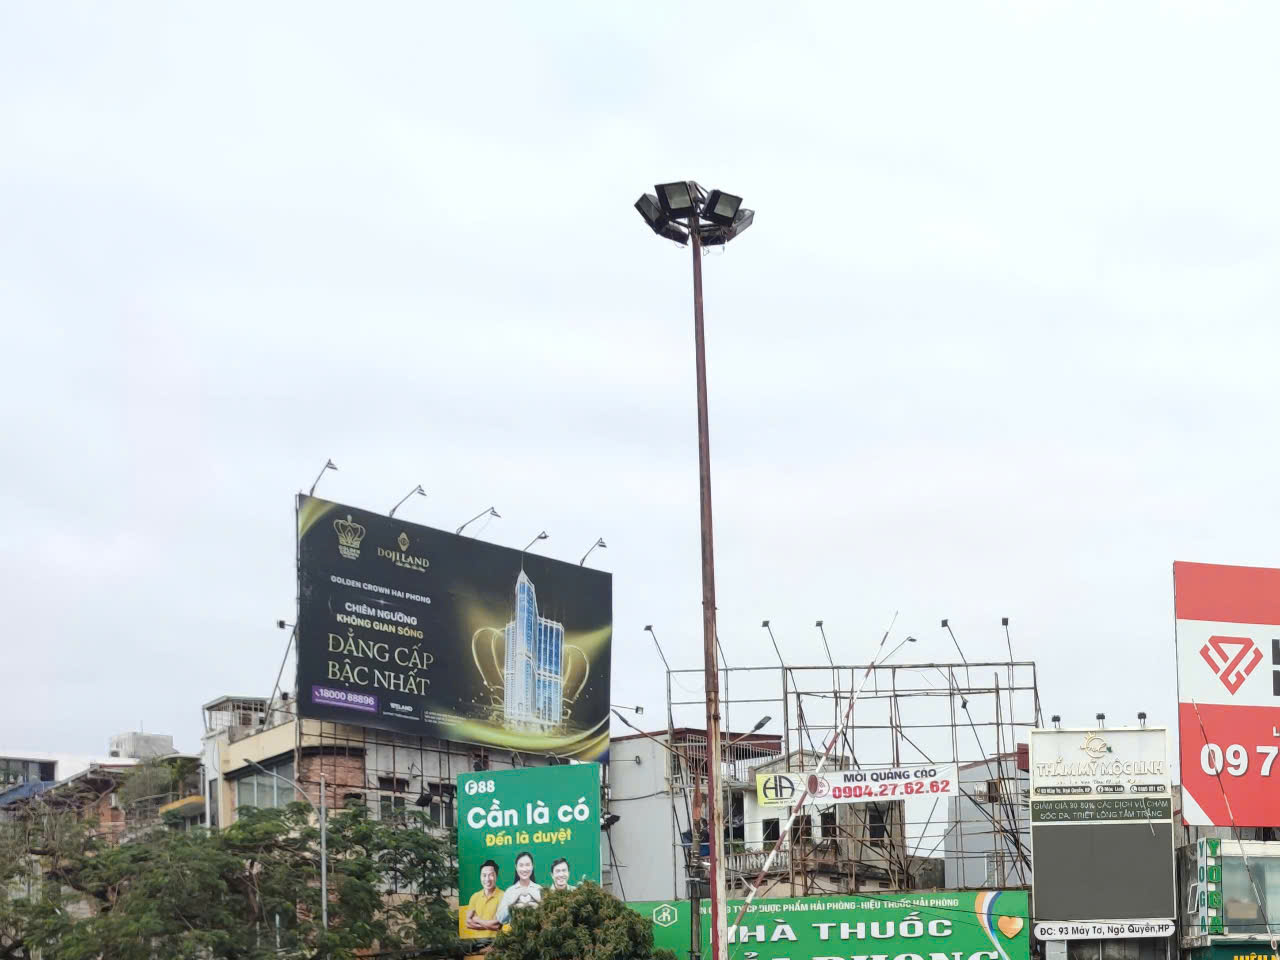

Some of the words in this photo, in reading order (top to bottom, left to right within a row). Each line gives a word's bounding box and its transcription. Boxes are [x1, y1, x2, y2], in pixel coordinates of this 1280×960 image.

[377, 547, 430, 568] DOJILAND
[330, 575, 361, 588] GOLDEN
[362, 582, 390, 595] CROWN
[405, 592, 431, 604] PHONG
[337, 613, 371, 629] KHÔNG
[373, 621, 396, 633] GIAN
[394, 643, 434, 670] CẤP
[328, 658, 369, 687] BẬC
[374, 669, 430, 695] NHẤT
[1077, 760, 1097, 776] MỸ
[1133, 761, 1163, 775] LINH
[1200, 743, 1249, 776] 09
[465, 779, 495, 795] F88
[832, 780, 950, 799] 0904.27.62.62
[467, 799, 519, 829] Cần
[526, 800, 549, 824] là
[557, 796, 590, 822] có
[486, 830, 512, 847] Đến
[516, 831, 529, 845] là
[533, 827, 572, 845] duyệt
[783, 900, 808, 911] PHẨM
[861, 899, 881, 911] HIỆU
[913, 896, 928, 908] HẢI
[811, 911, 953, 940] THUỐC
[1040, 926, 1056, 936] ĐC:
[1058, 926, 1069, 935] 93
[1071, 925, 1090, 937] Máy
[1107, 924, 1125, 935] Ngô
